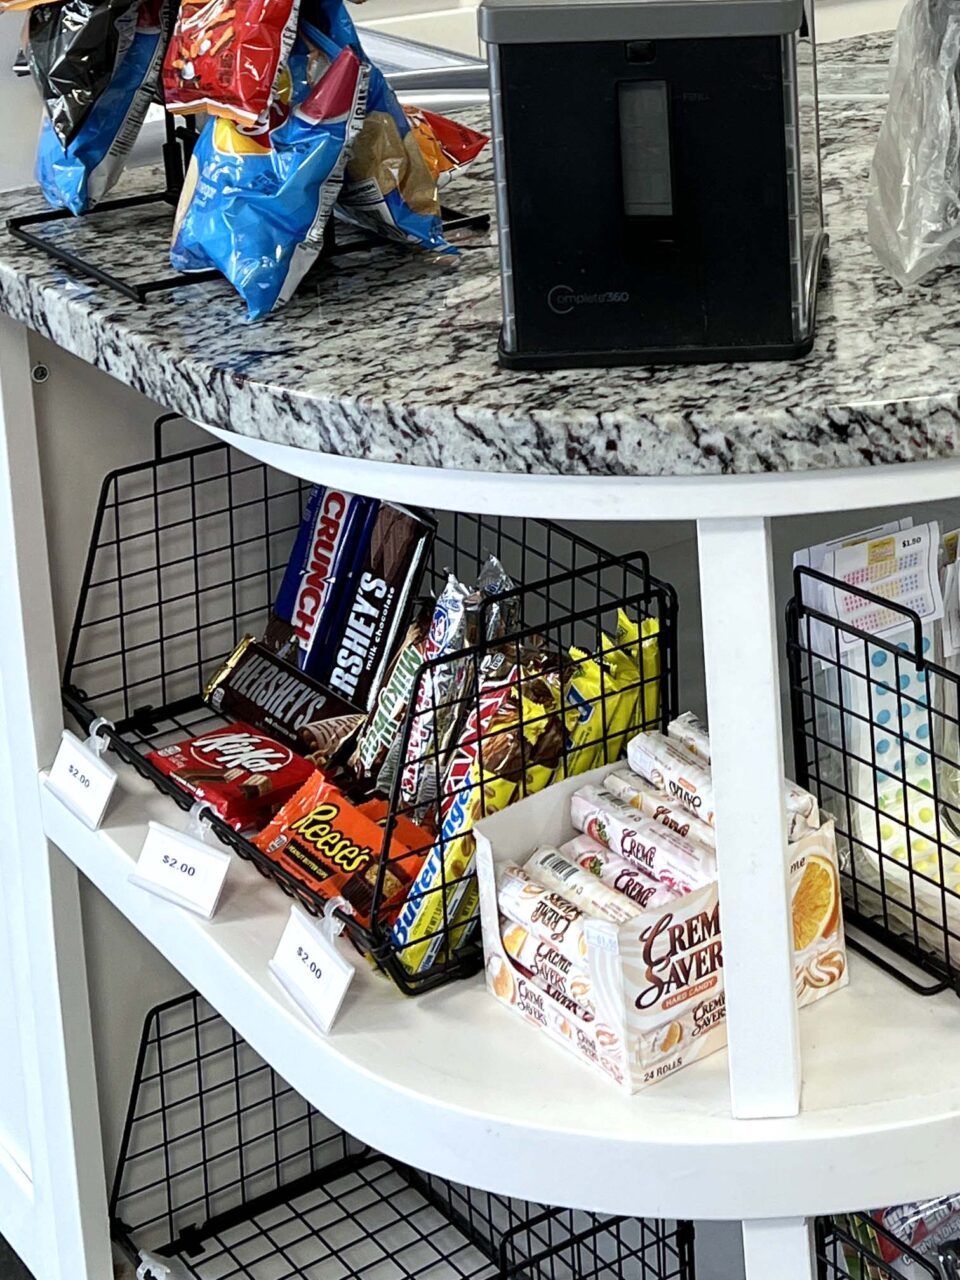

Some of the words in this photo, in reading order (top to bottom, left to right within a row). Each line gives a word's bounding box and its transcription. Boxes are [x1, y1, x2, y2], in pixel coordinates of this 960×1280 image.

[902, 537, 922, 548] $1.50
[293, 491, 345, 648] CRUNCH
[366, 645, 378, 671] milk
[373, 587, 396, 644] chocolate
[228, 653, 328, 727] HERSHEY'S
[67, 764, 91, 789] $2.00
[291, 804, 370, 870] Reese's
[162, 855, 196, 877] $2.00
[639, 912, 722, 967] CREM
[296, 946, 323, 980] $2.00
[635, 940, 723, 1010] SAVER
[665, 989, 689, 1008] HARD
[688, 979, 716, 999] CANDY
[644, 1070, 655, 1082] 24
[657, 1057, 683, 1077] ROLLS
